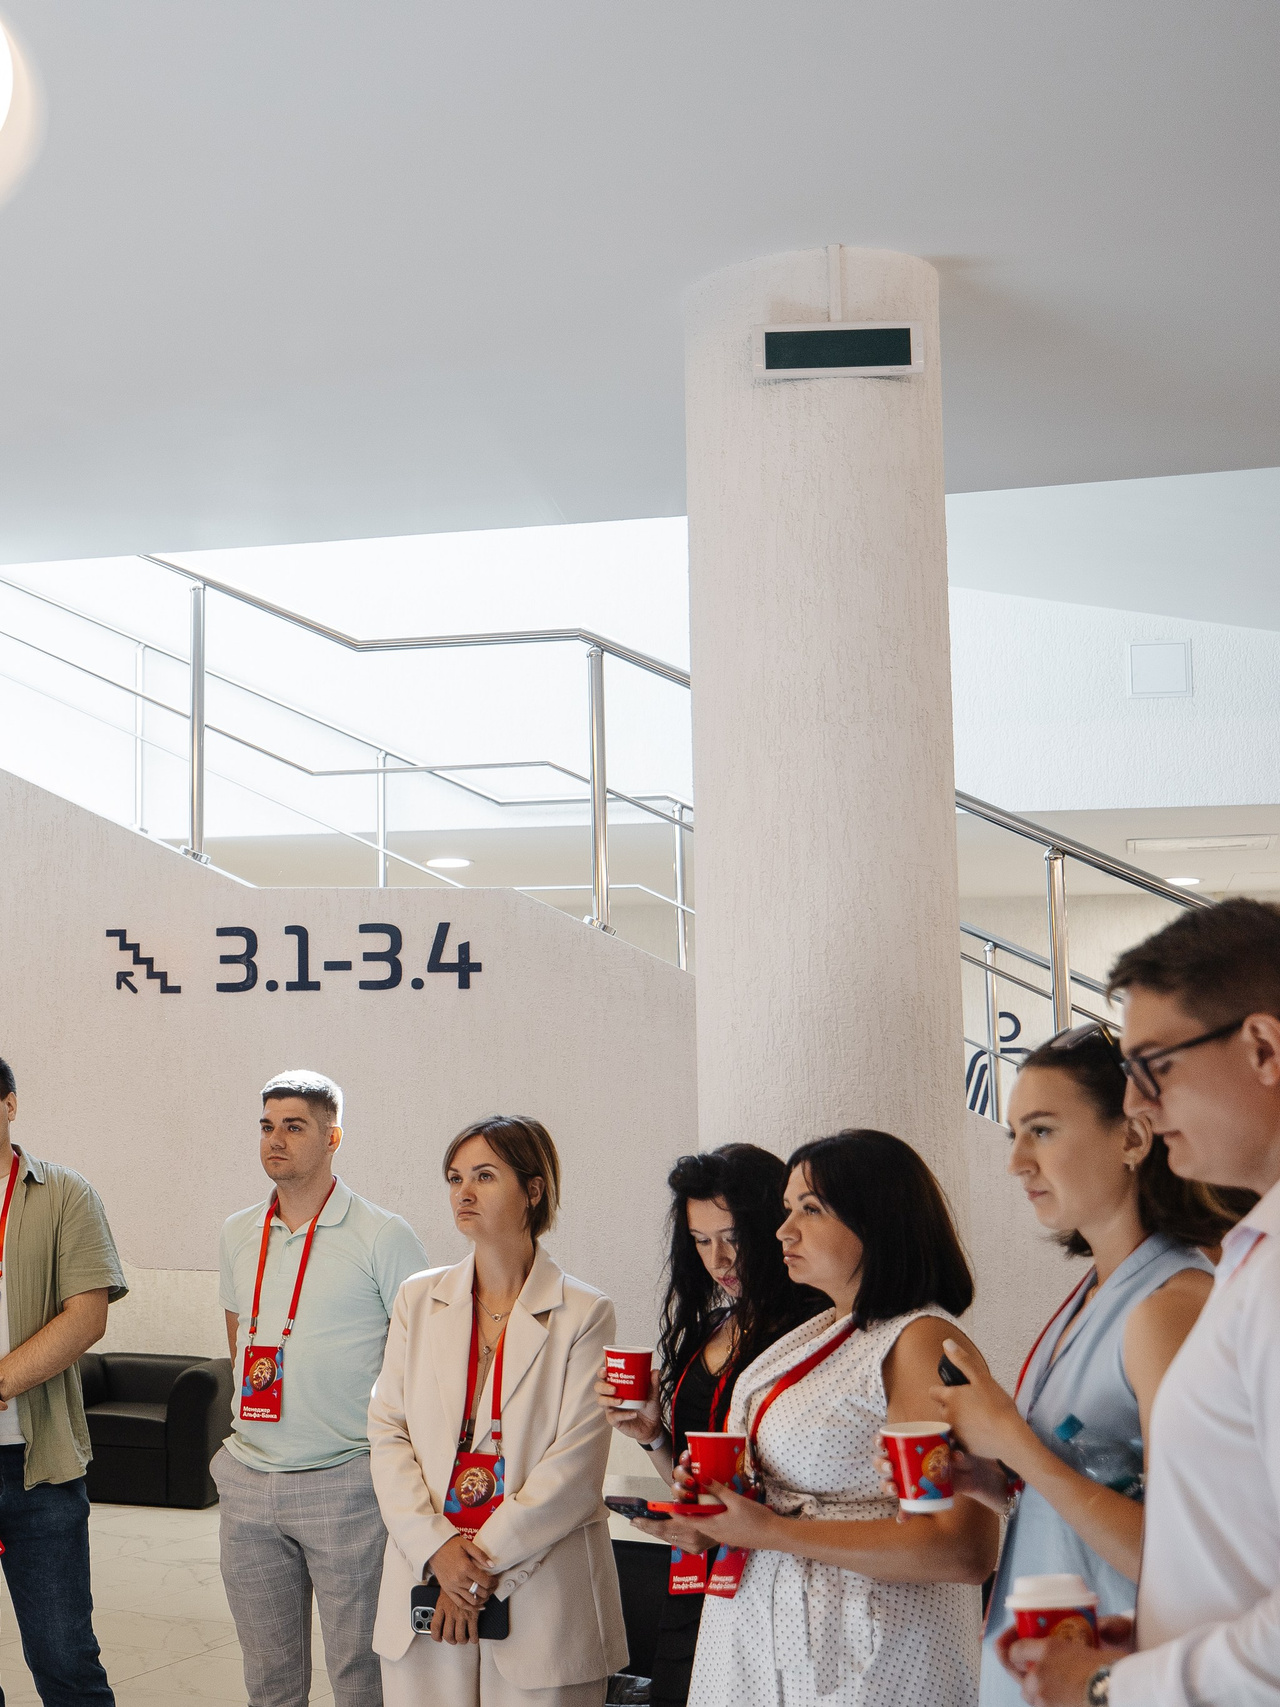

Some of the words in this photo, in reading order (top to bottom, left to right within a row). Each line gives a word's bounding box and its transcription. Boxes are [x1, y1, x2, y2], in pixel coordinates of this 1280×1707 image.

[215, 922, 482, 993] 3.1-3.4
[242, 1406, 271, 1414] Менеджер
[242, 1411, 278, 1419] Альфа-Банка
